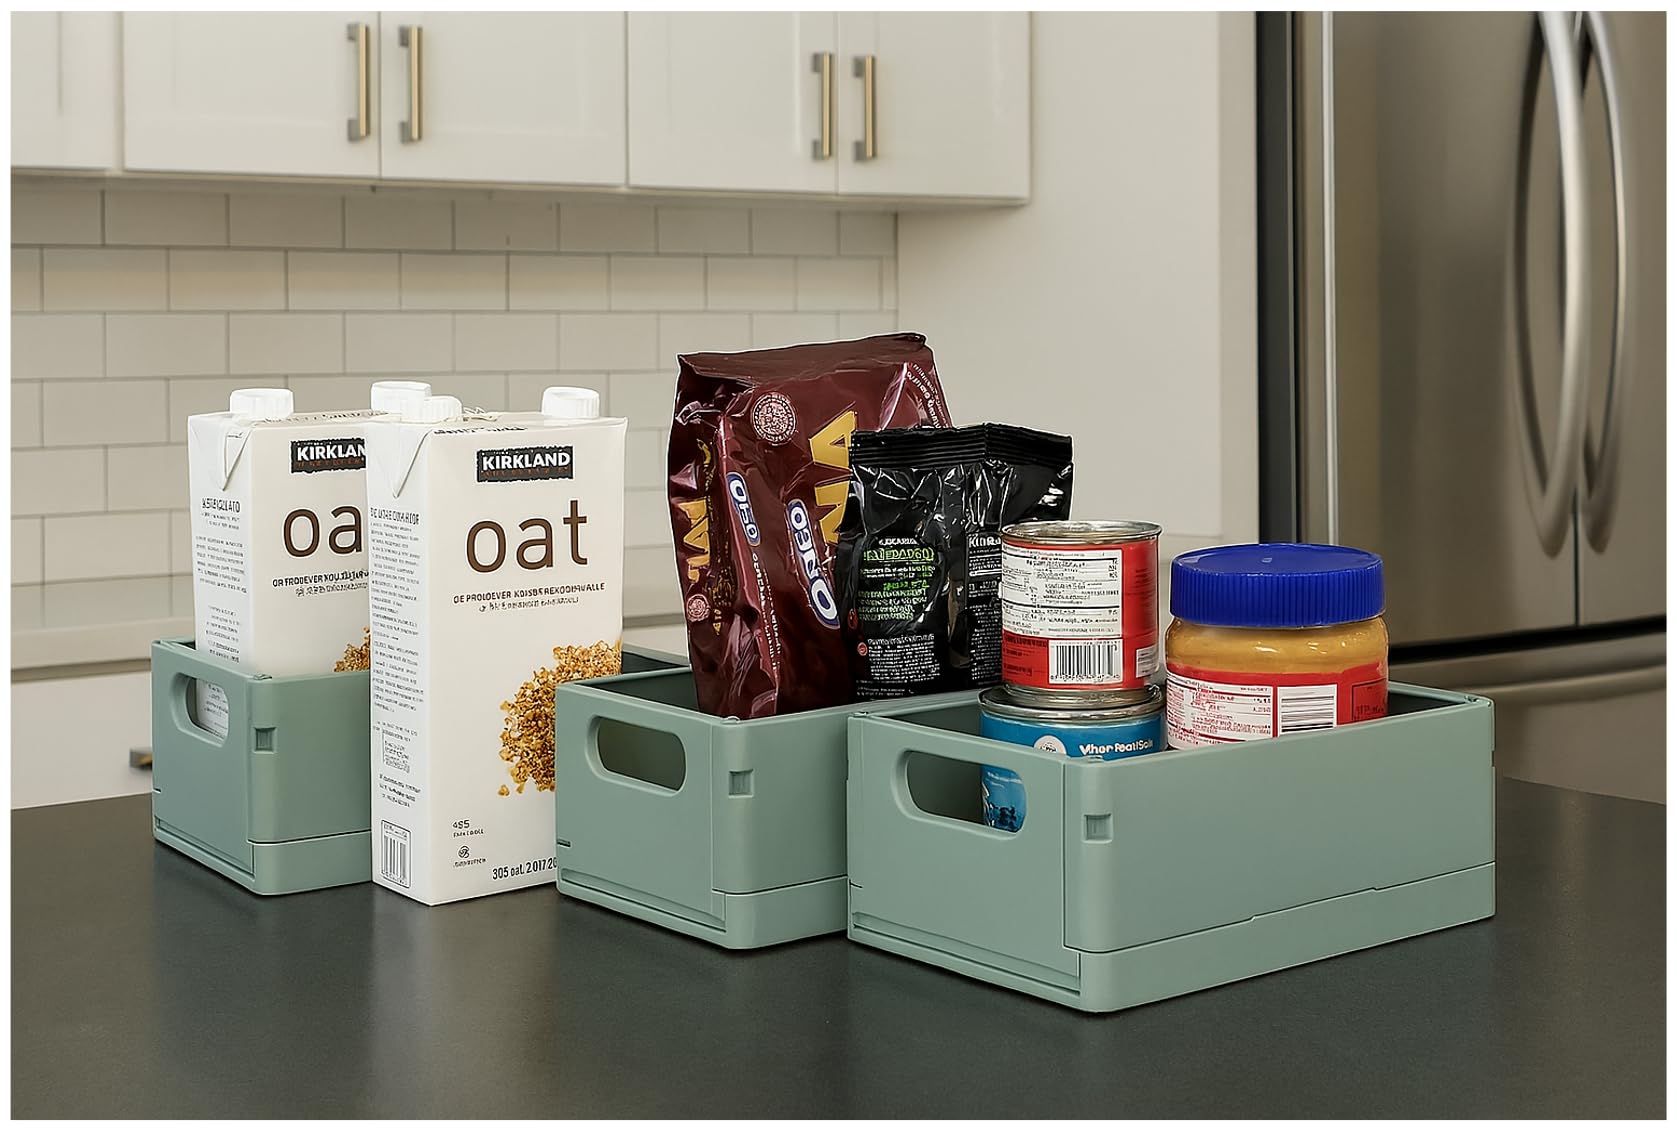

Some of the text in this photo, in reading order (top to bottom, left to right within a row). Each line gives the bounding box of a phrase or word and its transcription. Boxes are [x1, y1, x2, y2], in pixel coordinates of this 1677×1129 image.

[482, 453, 571, 471] KIRKLAND
[283, 505, 363, 558] oa
[466, 499, 588, 574] oat
[492, 866, 509, 880] 305
